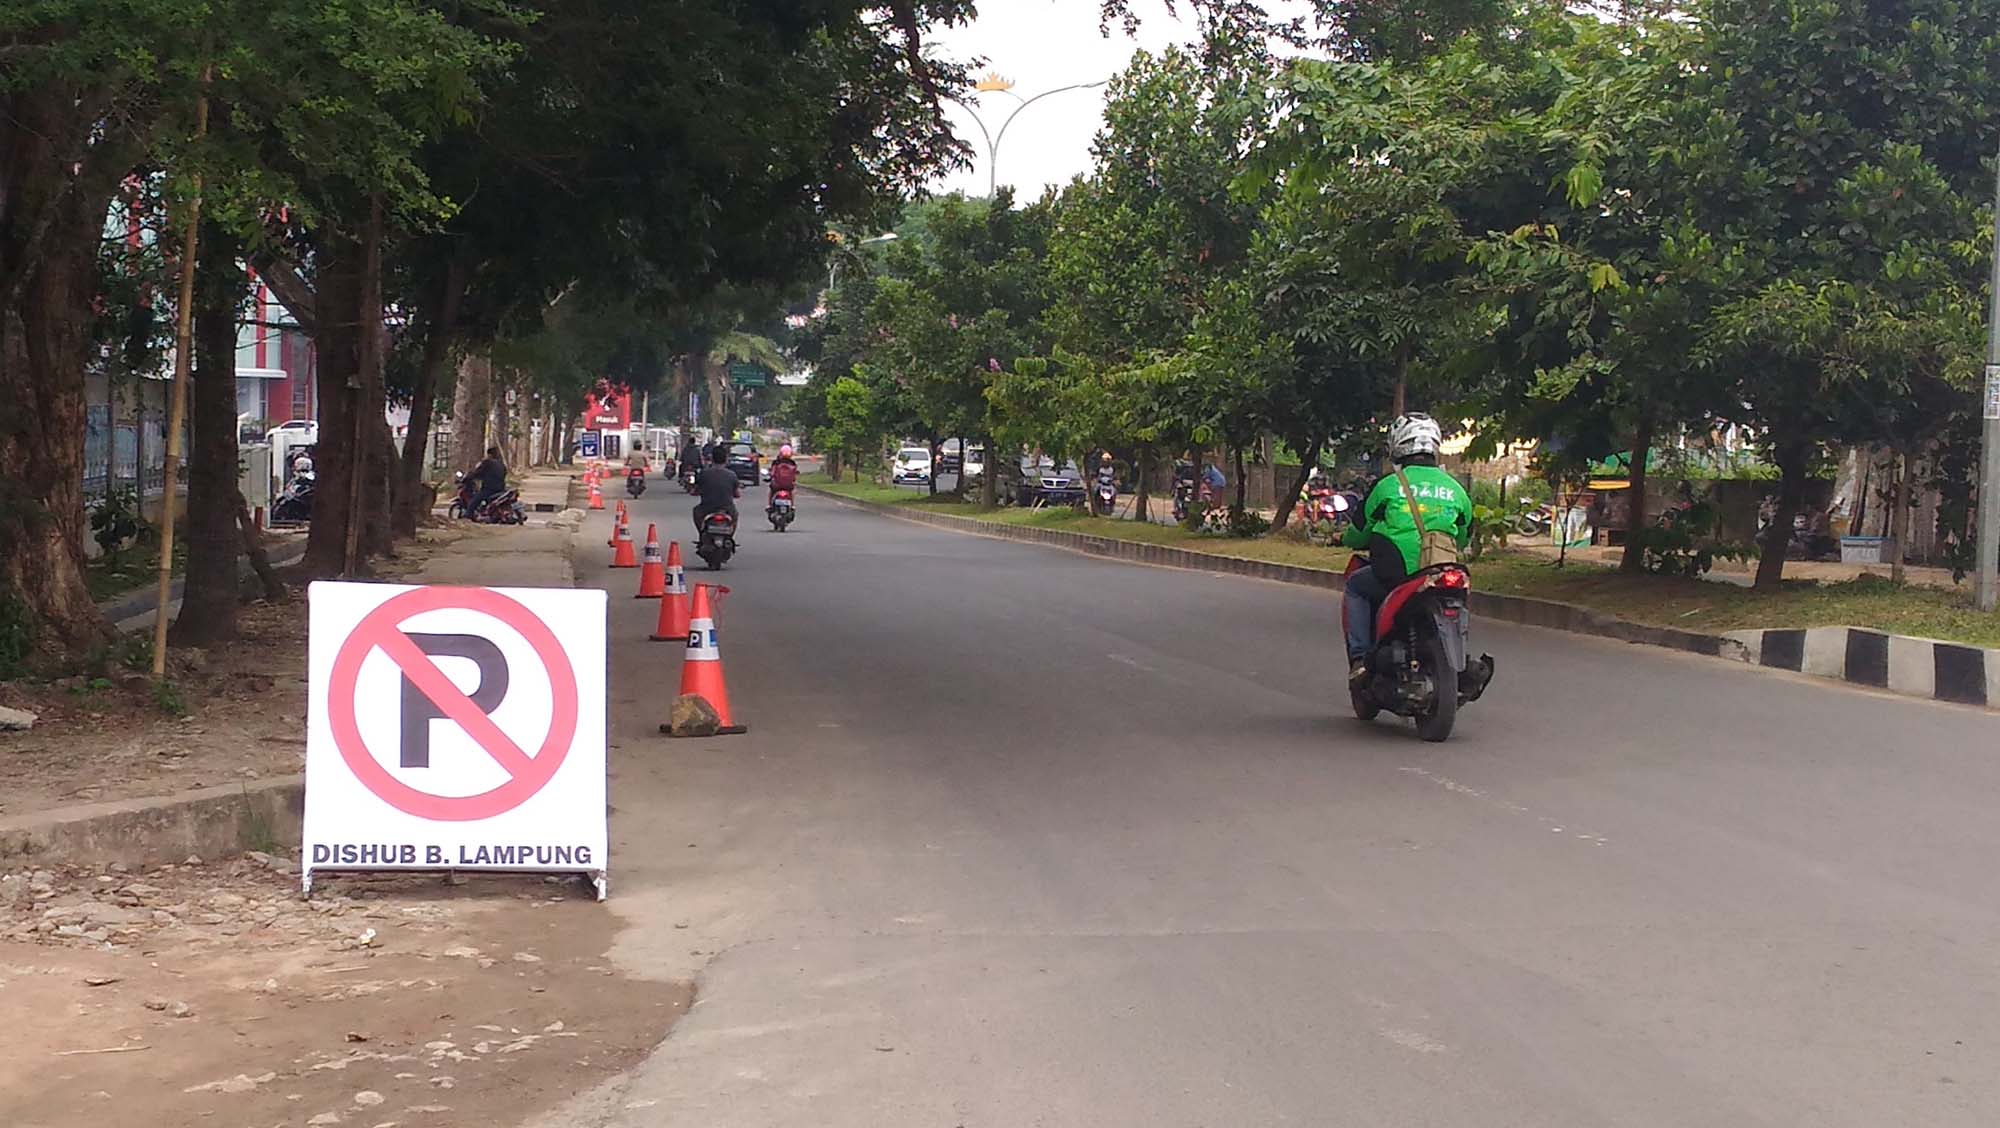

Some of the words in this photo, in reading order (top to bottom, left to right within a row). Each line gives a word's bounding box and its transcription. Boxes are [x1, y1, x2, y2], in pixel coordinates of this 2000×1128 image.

[1434, 485, 1455, 502] JEK
[689, 632, 700, 647] P
[399, 631, 510, 769] P
[311, 843, 417, 864] DISHUB
[425, 845, 450, 864] B.
[458, 845, 593, 865] LAMPUNG
